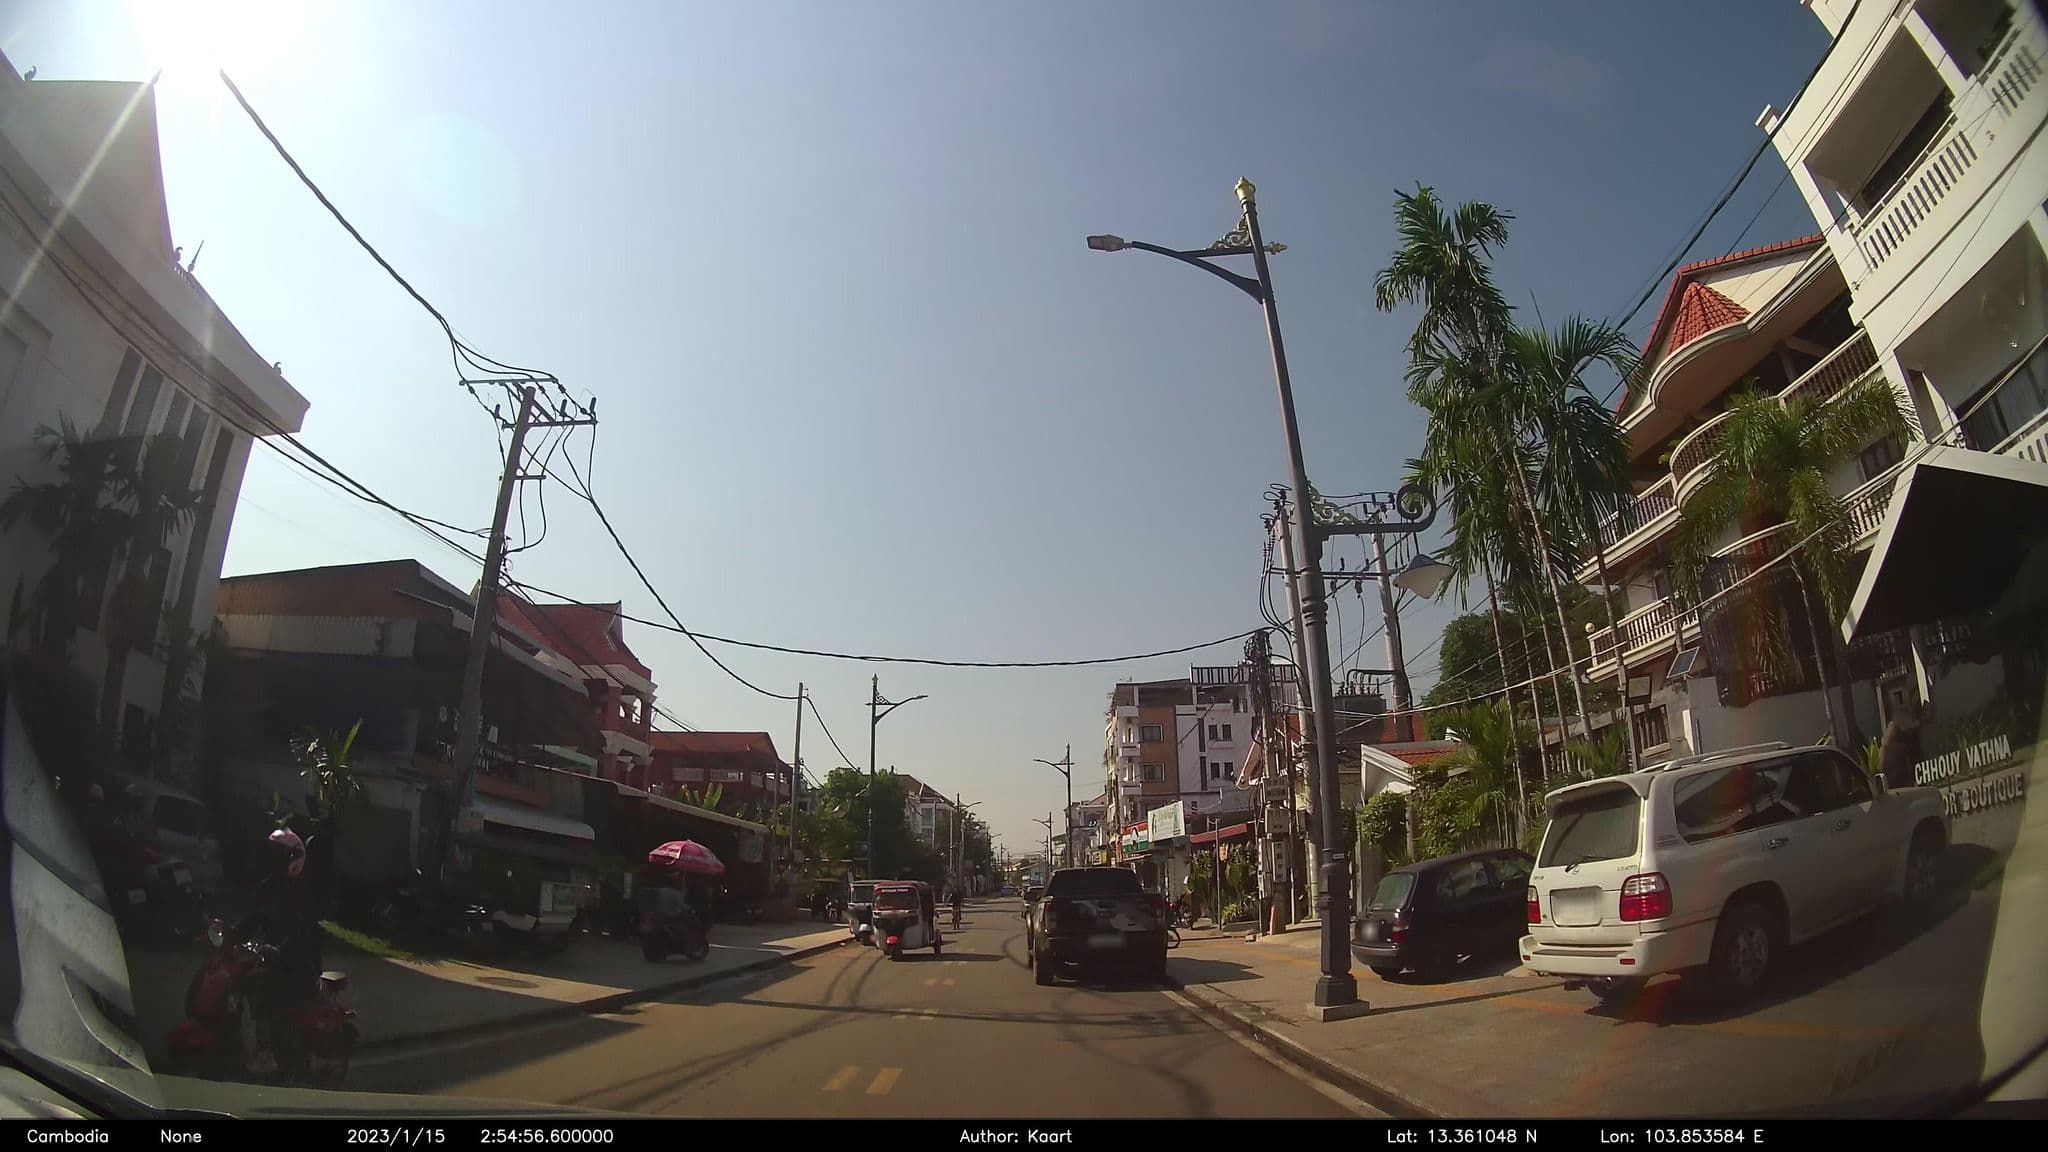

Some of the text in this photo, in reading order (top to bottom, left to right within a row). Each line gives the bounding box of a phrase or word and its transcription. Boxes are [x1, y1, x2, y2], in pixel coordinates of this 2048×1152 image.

[1914, 735, 2011, 785] CHHOUY VATHNA
[1962, 774, 2023, 811] BOUTIQUE
